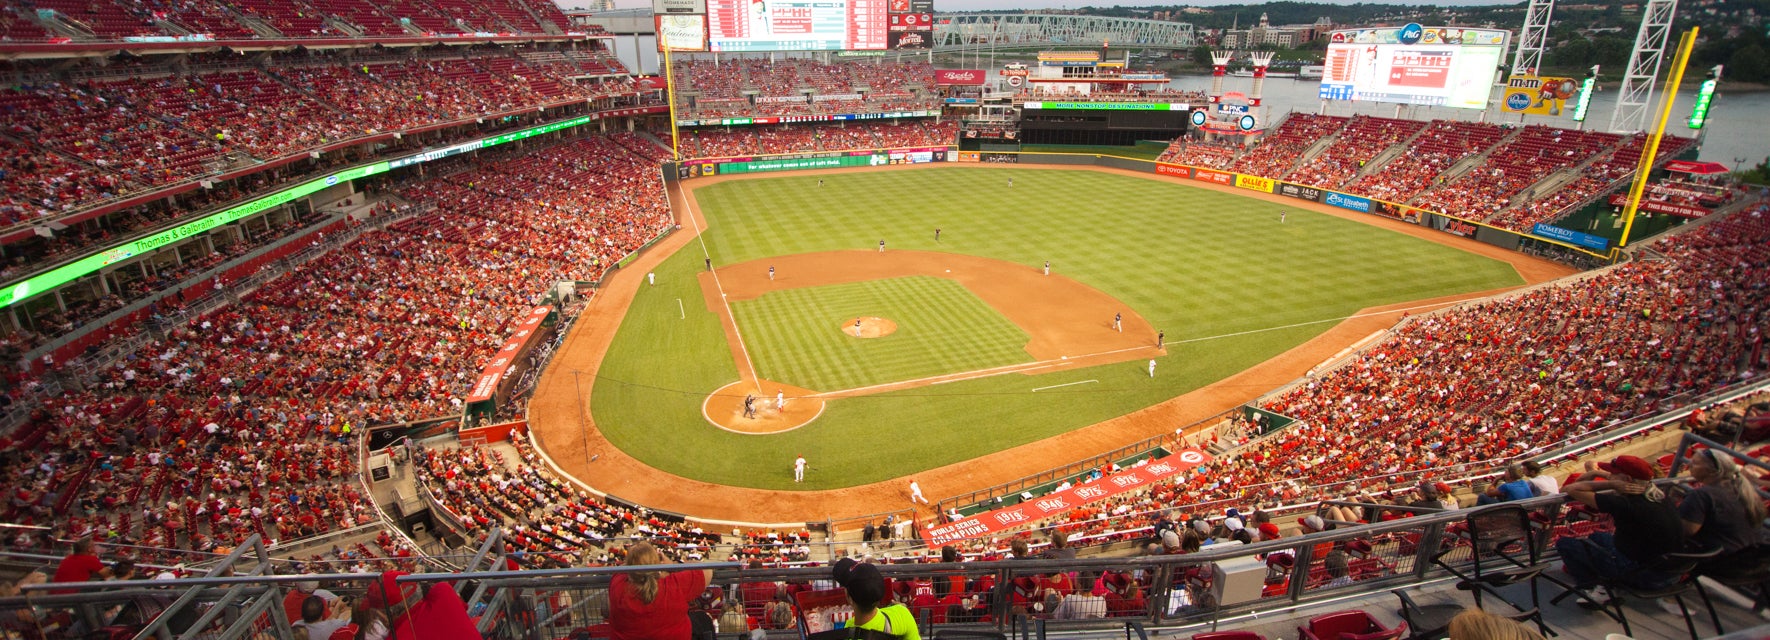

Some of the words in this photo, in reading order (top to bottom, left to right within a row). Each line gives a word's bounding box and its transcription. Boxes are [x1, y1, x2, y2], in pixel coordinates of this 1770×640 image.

[1402, 29, 1420, 39] P&G
[944, 71, 975, 80] Reds
[1166, 166, 1188, 175] TOYOTA
[1242, 177, 1268, 188] OLLIE'S
[1301, 187, 1319, 196] JACK
[1344, 198, 1368, 208] Elizabeth
[1661, 204, 1679, 212] BUD'S
[1680, 207, 1692, 215] FOR
[134, 233, 171, 252] Thomas
[172, 230, 179, 239] &
[180, 218, 215, 236] Galbraith
[227, 191, 293, 218] ThomasGalbraith.com
[1538, 223, 1574, 237] POMEROY
[1113, 476, 1138, 486] 1976
[1078, 487, 1102, 498] 1975
[1038, 500, 1063, 510] 1940
[997, 512, 1022, 523] 1919
[929, 524, 955, 537] WORLD
[956, 518, 980, 530] SERIES
[932, 524, 989, 546] CHAMPIONS
